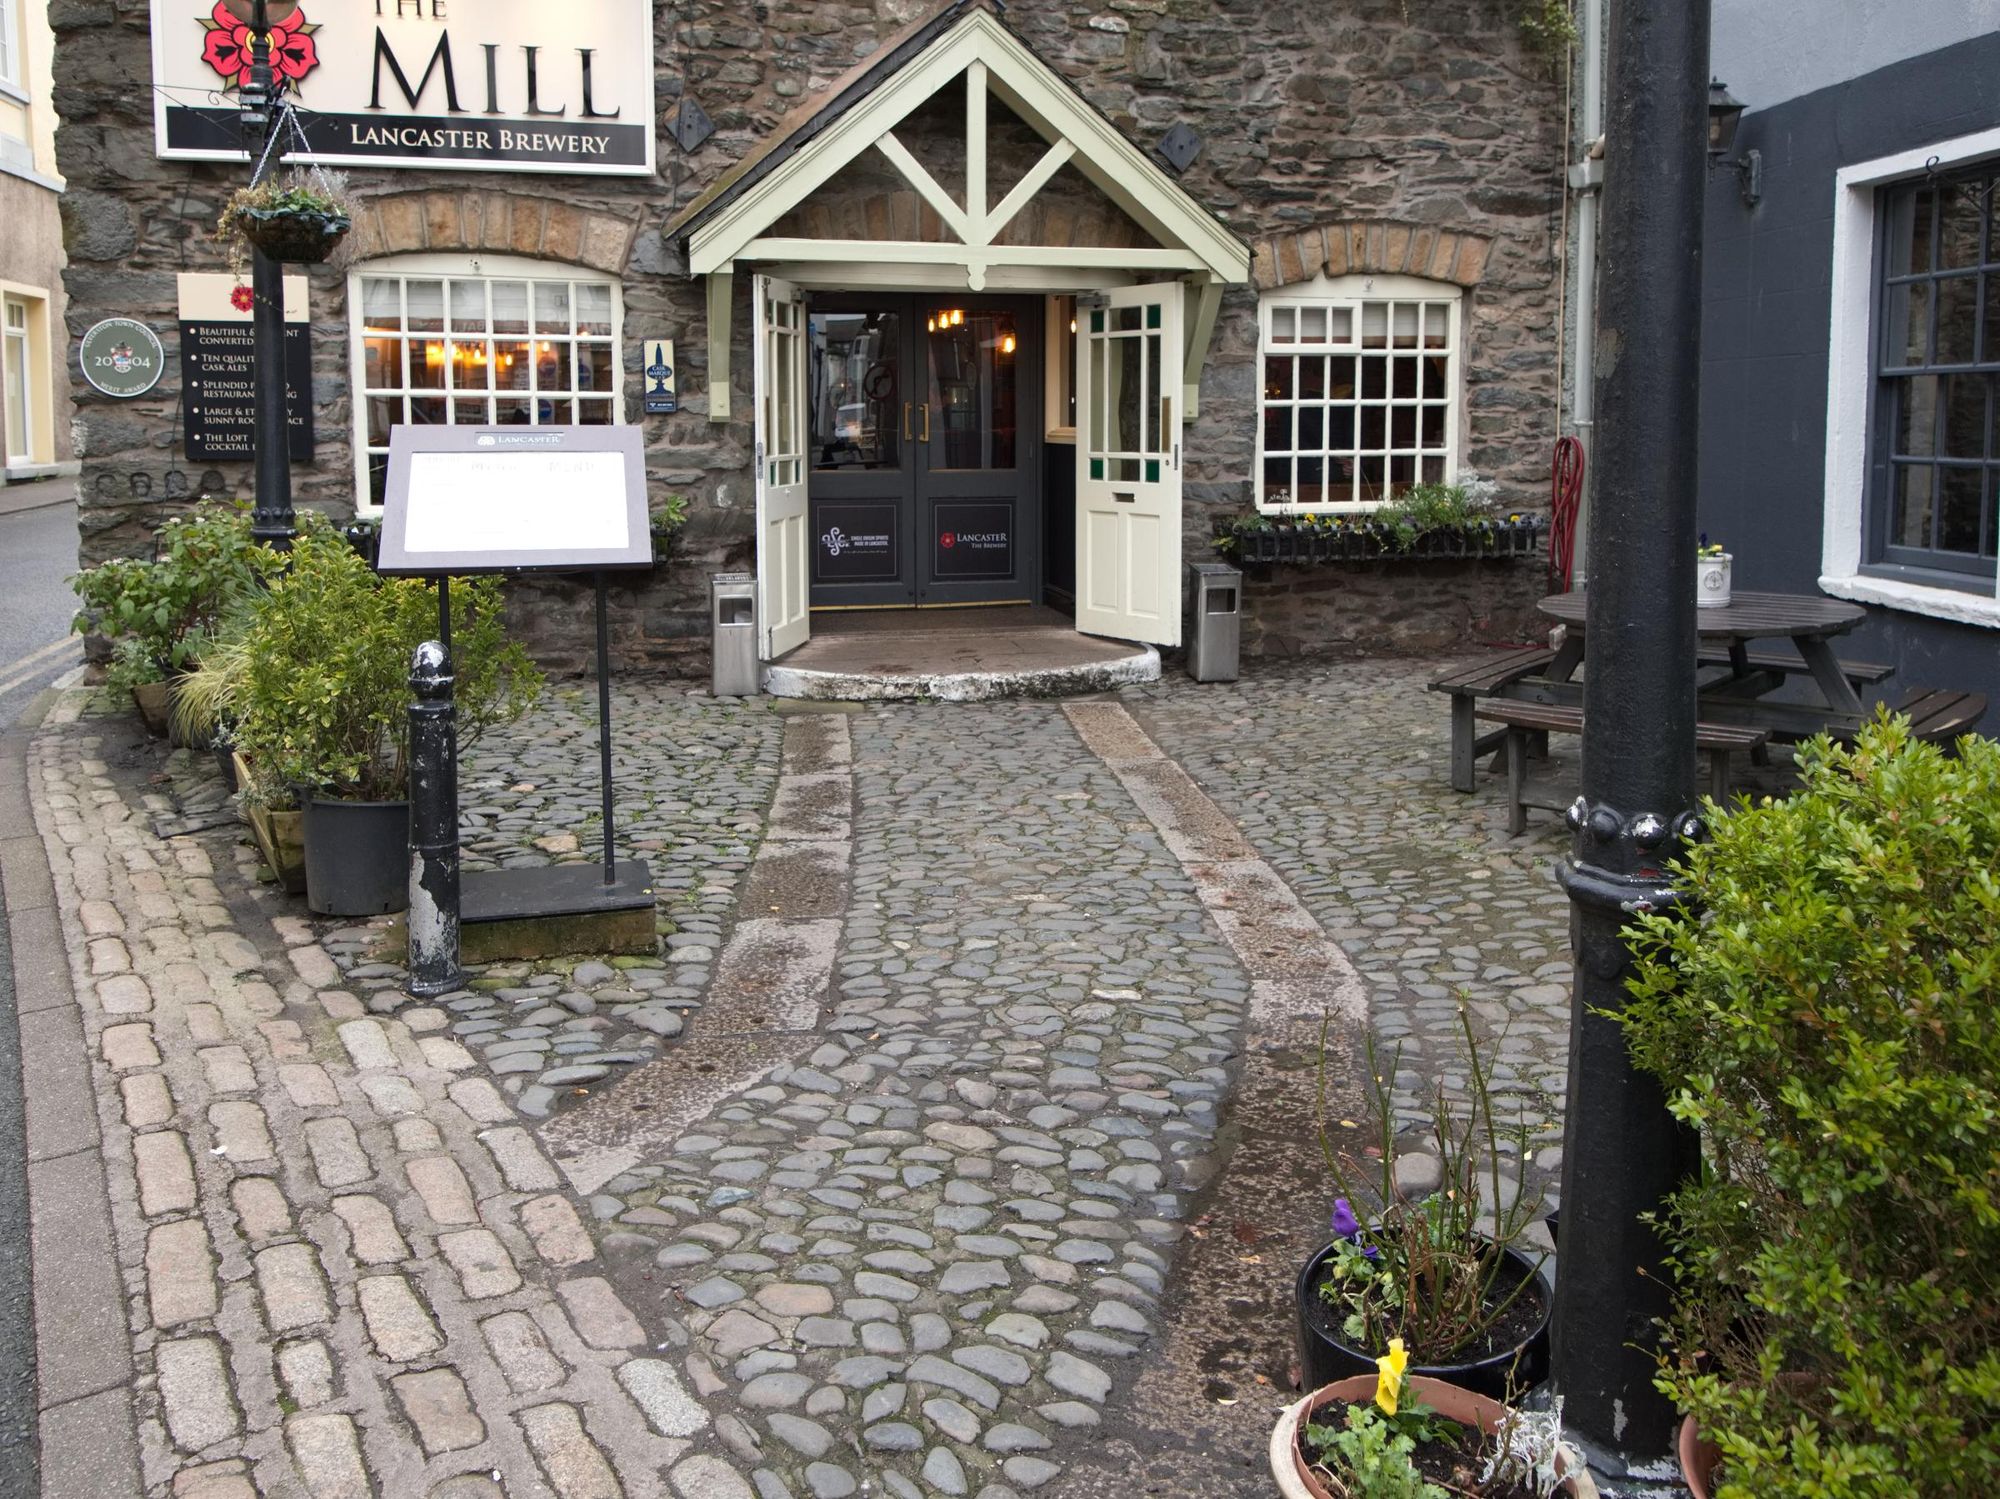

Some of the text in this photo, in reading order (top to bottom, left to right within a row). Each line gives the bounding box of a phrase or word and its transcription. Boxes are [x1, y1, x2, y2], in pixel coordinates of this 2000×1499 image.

[364, 25, 620, 118] MILL
[351, 124, 610, 153] LANCASTER BREWERY
[200, 327, 247, 337] BEAUTIFUL
[200, 337, 254, 345] CONVERTED
[201, 354, 255, 365] TEN QUALIT
[202, 364, 247, 372] CASK ALES
[203, 380, 248, 389] SPLENDID
[203, 390, 256, 399] RESTAURAN
[204, 407, 233, 416] LARGE
[235, 407, 243, 416] &
[204, 417, 236, 425] SUNNY
[205, 433, 248, 442] THE LOFT
[498, 435, 560, 444] LANCASTER
[205, 443, 249, 451] COCKTAIL
[957, 533, 1007, 542] LANCASTER
